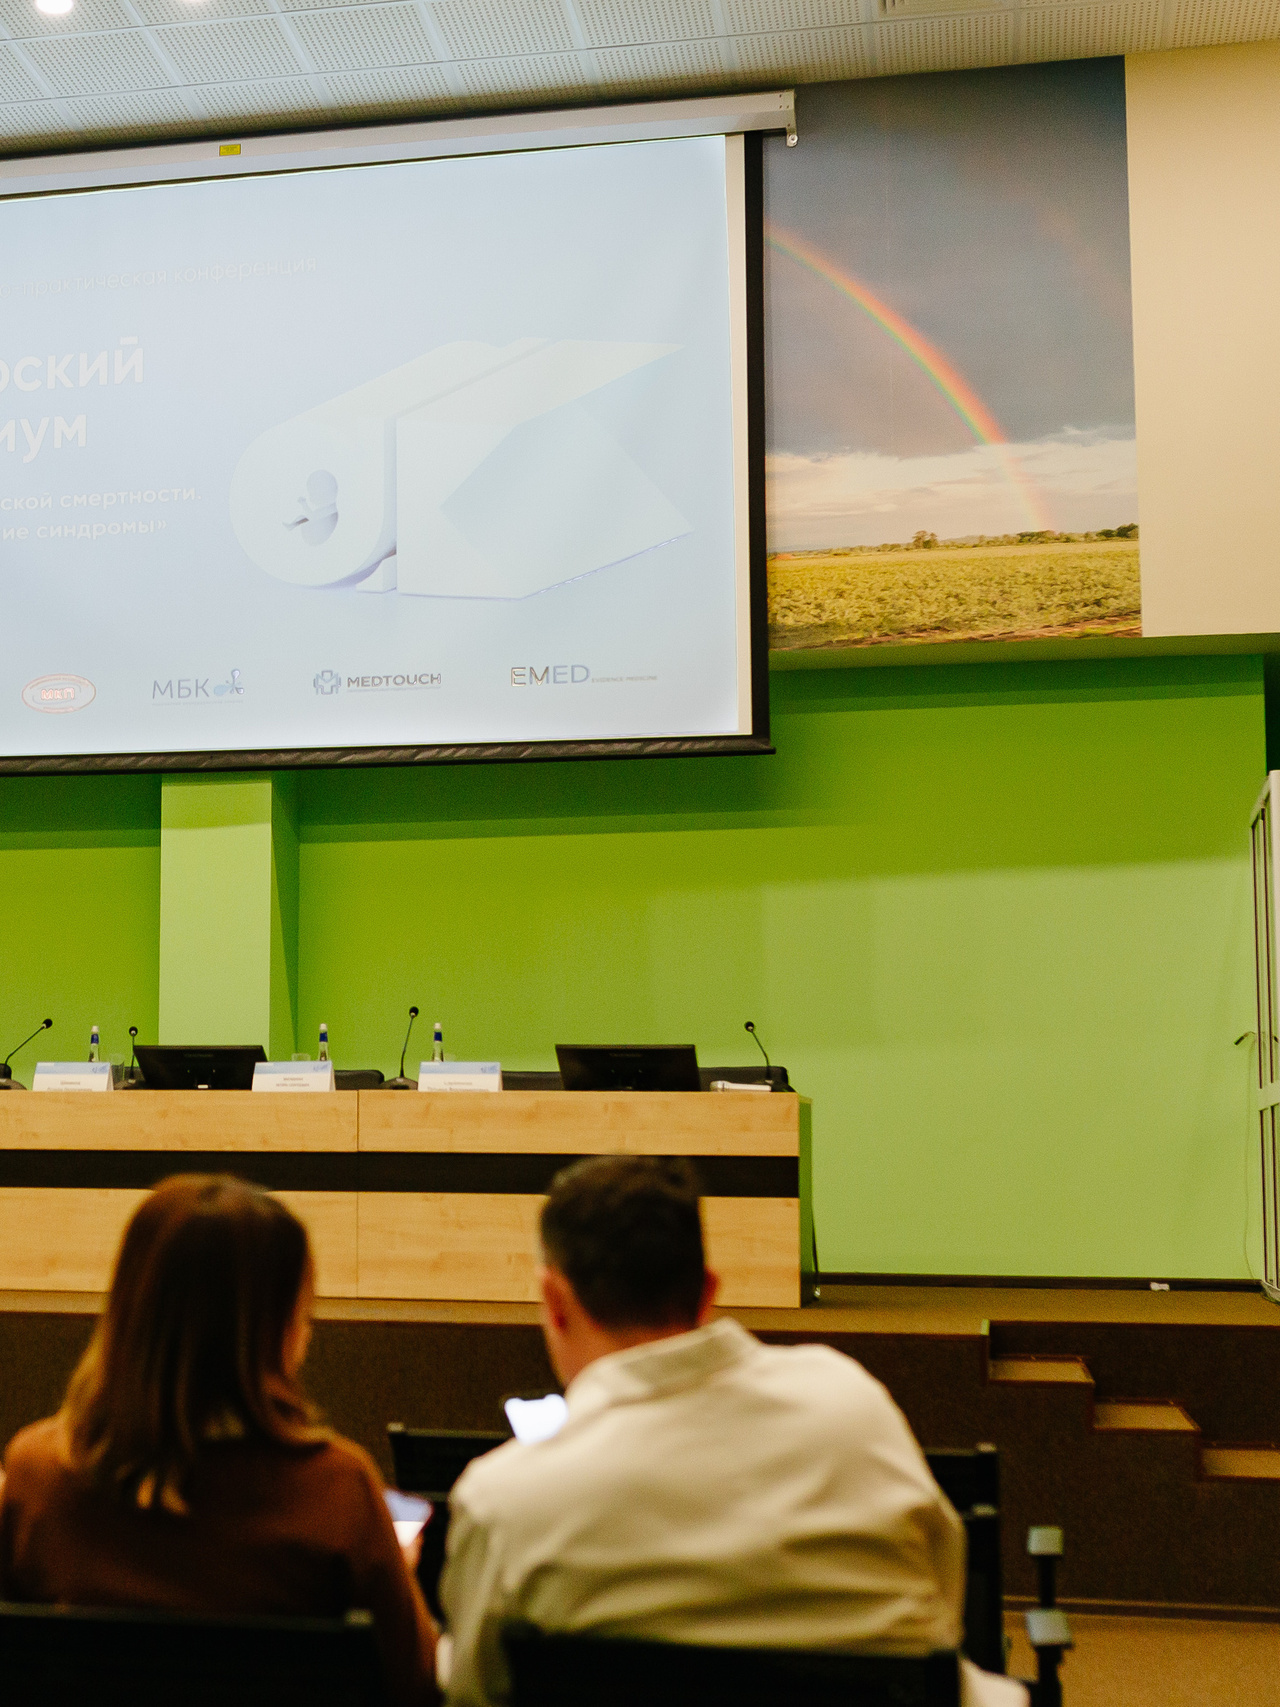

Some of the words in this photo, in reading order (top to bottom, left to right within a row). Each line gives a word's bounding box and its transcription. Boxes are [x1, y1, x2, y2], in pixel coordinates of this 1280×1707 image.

[174, 255, 317, 285] конференция
[60, 485, 202, 514] смертности.
[36, 518, 168, 544] синдромы»
[347, 673, 442, 688] MEDTOUCH
[511, 664, 590, 686] EMED
[152, 678, 210, 700] МБК
